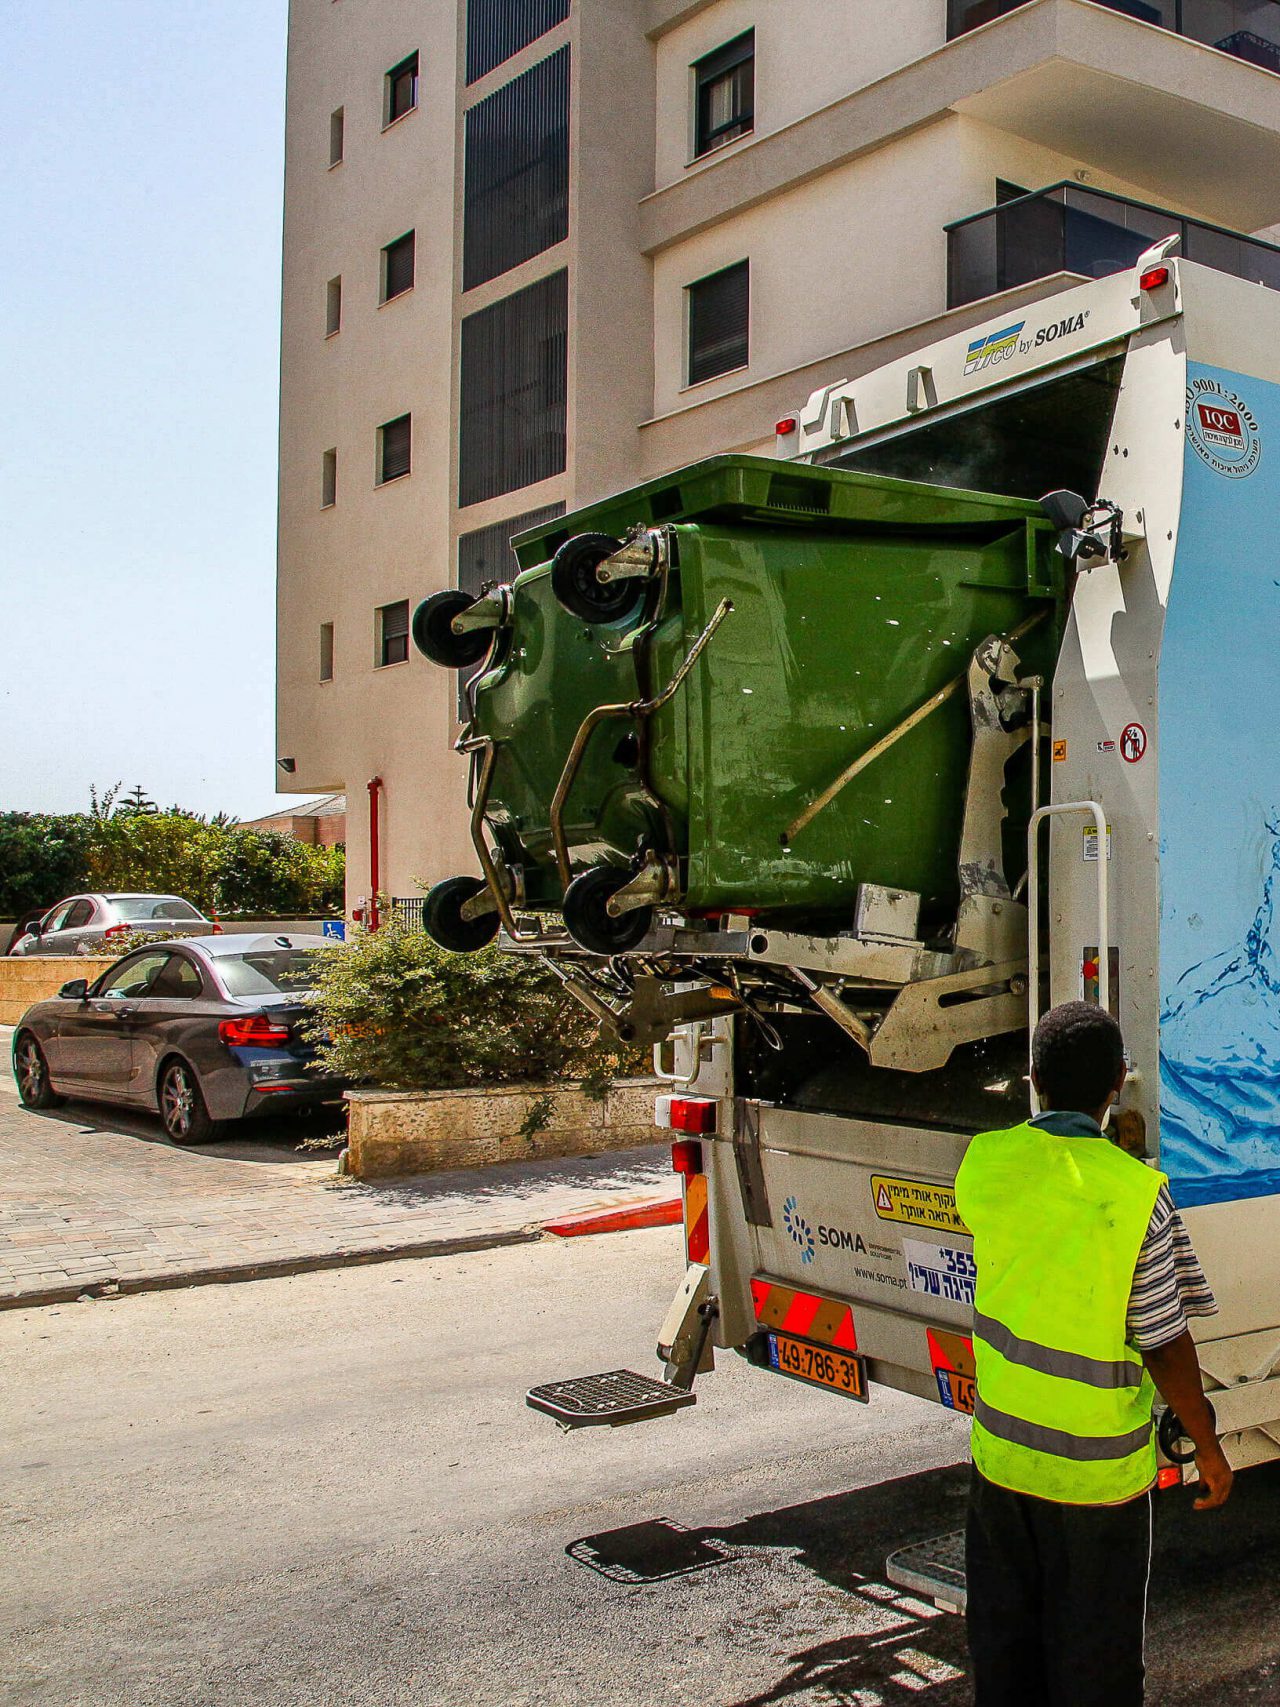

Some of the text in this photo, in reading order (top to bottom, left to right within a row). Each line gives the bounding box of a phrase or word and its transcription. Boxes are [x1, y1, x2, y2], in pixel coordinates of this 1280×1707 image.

[1019, 338, 1034, 354] by
[1204, 409, 1235, 430] IQC
[887, 1184, 956, 1209] עקוף אותי מימין
[927, 1209, 951, 1223] רואה
[818, 1225, 867, 1255] SOMA
[854, 1267, 908, 1290] www.soma.pt
[942, 1274, 976, 1304] היגה
